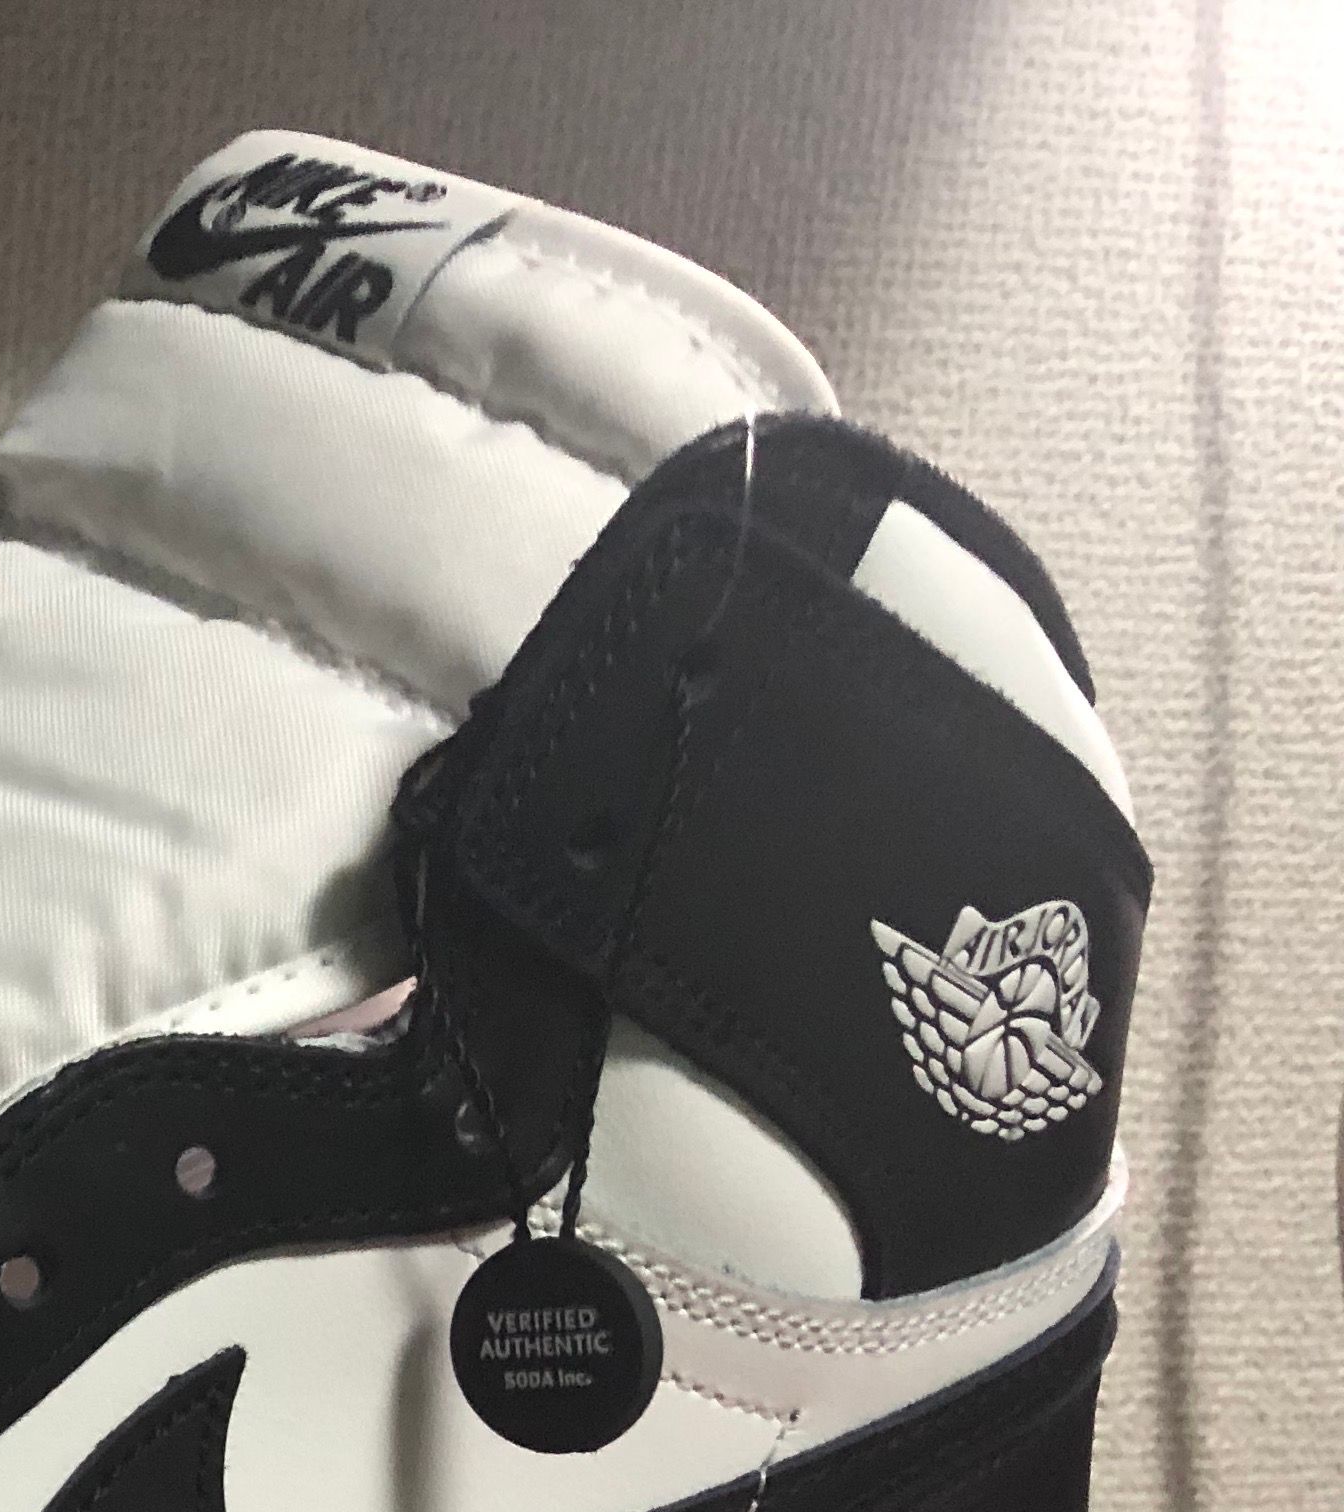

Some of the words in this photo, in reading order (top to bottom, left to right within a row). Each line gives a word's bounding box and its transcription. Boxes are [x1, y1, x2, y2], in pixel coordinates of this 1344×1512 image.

[238, 228, 395, 345] AIR
[486, 1307, 597, 1335] VERIFIED
[479, 1331, 610, 1362] AUTHENTIC
[503, 1370, 554, 1391] SODA
[558, 1368, 593, 1388] Inc.
